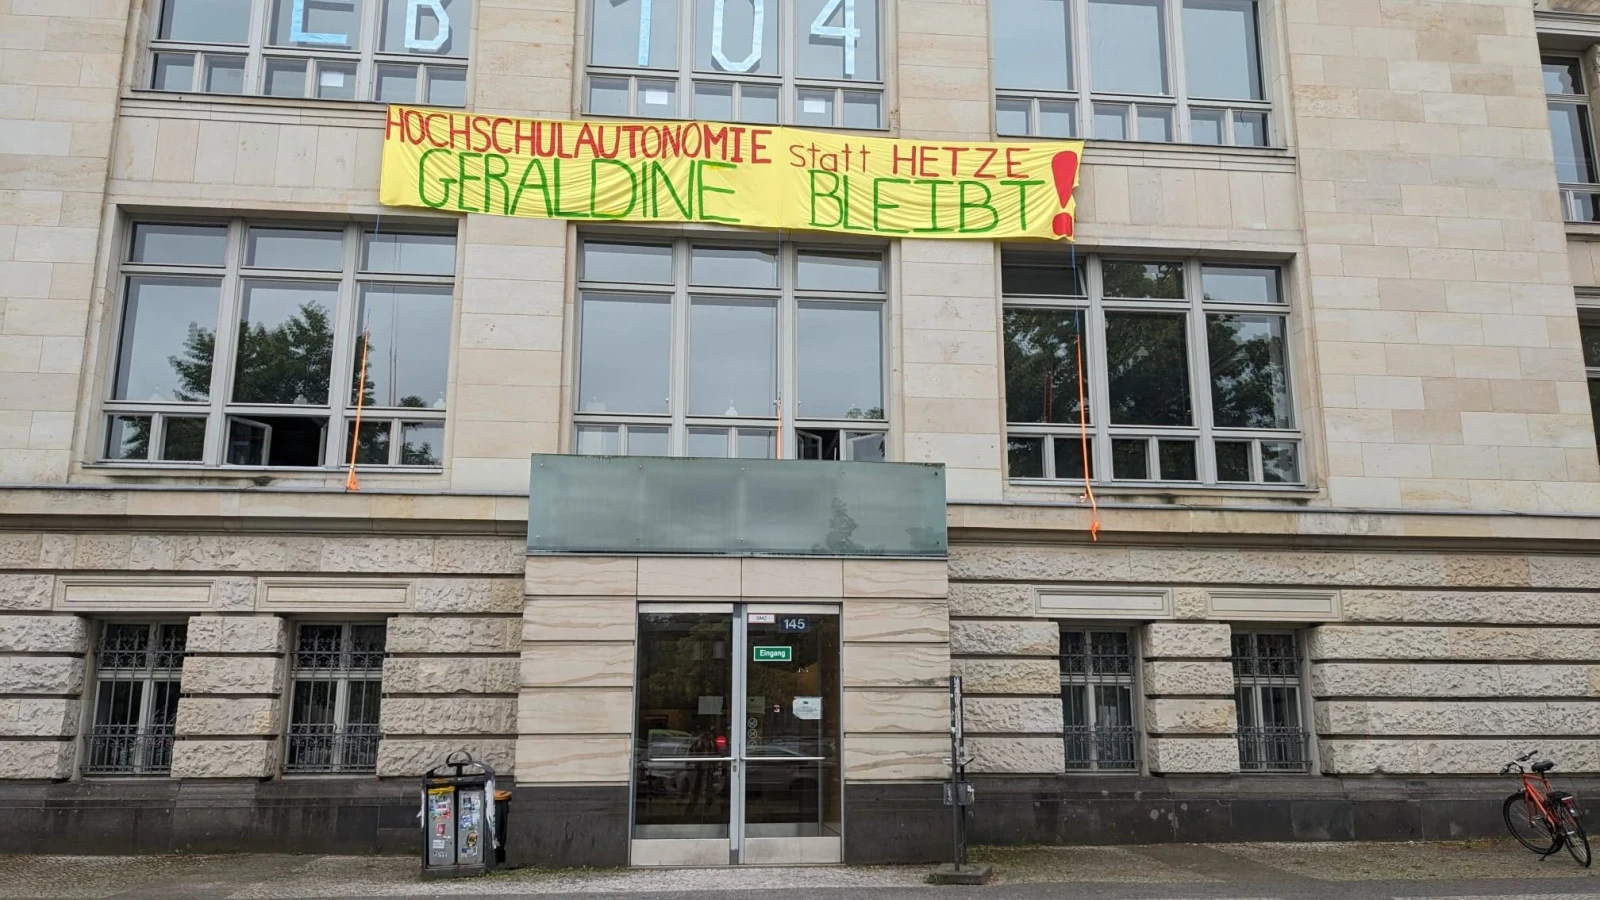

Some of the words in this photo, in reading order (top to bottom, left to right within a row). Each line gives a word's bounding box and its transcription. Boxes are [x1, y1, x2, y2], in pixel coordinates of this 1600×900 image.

[386, 105, 772, 164] HOCHSCHULAUTONOMIE
[892, 144, 1030, 178] HETZE
[419, 148, 741, 223] GERALDINE
[808, 169, 1046, 233] BLEIBT
[783, 618, 806, 629] 145
[759, 649, 786, 658] Eingang
